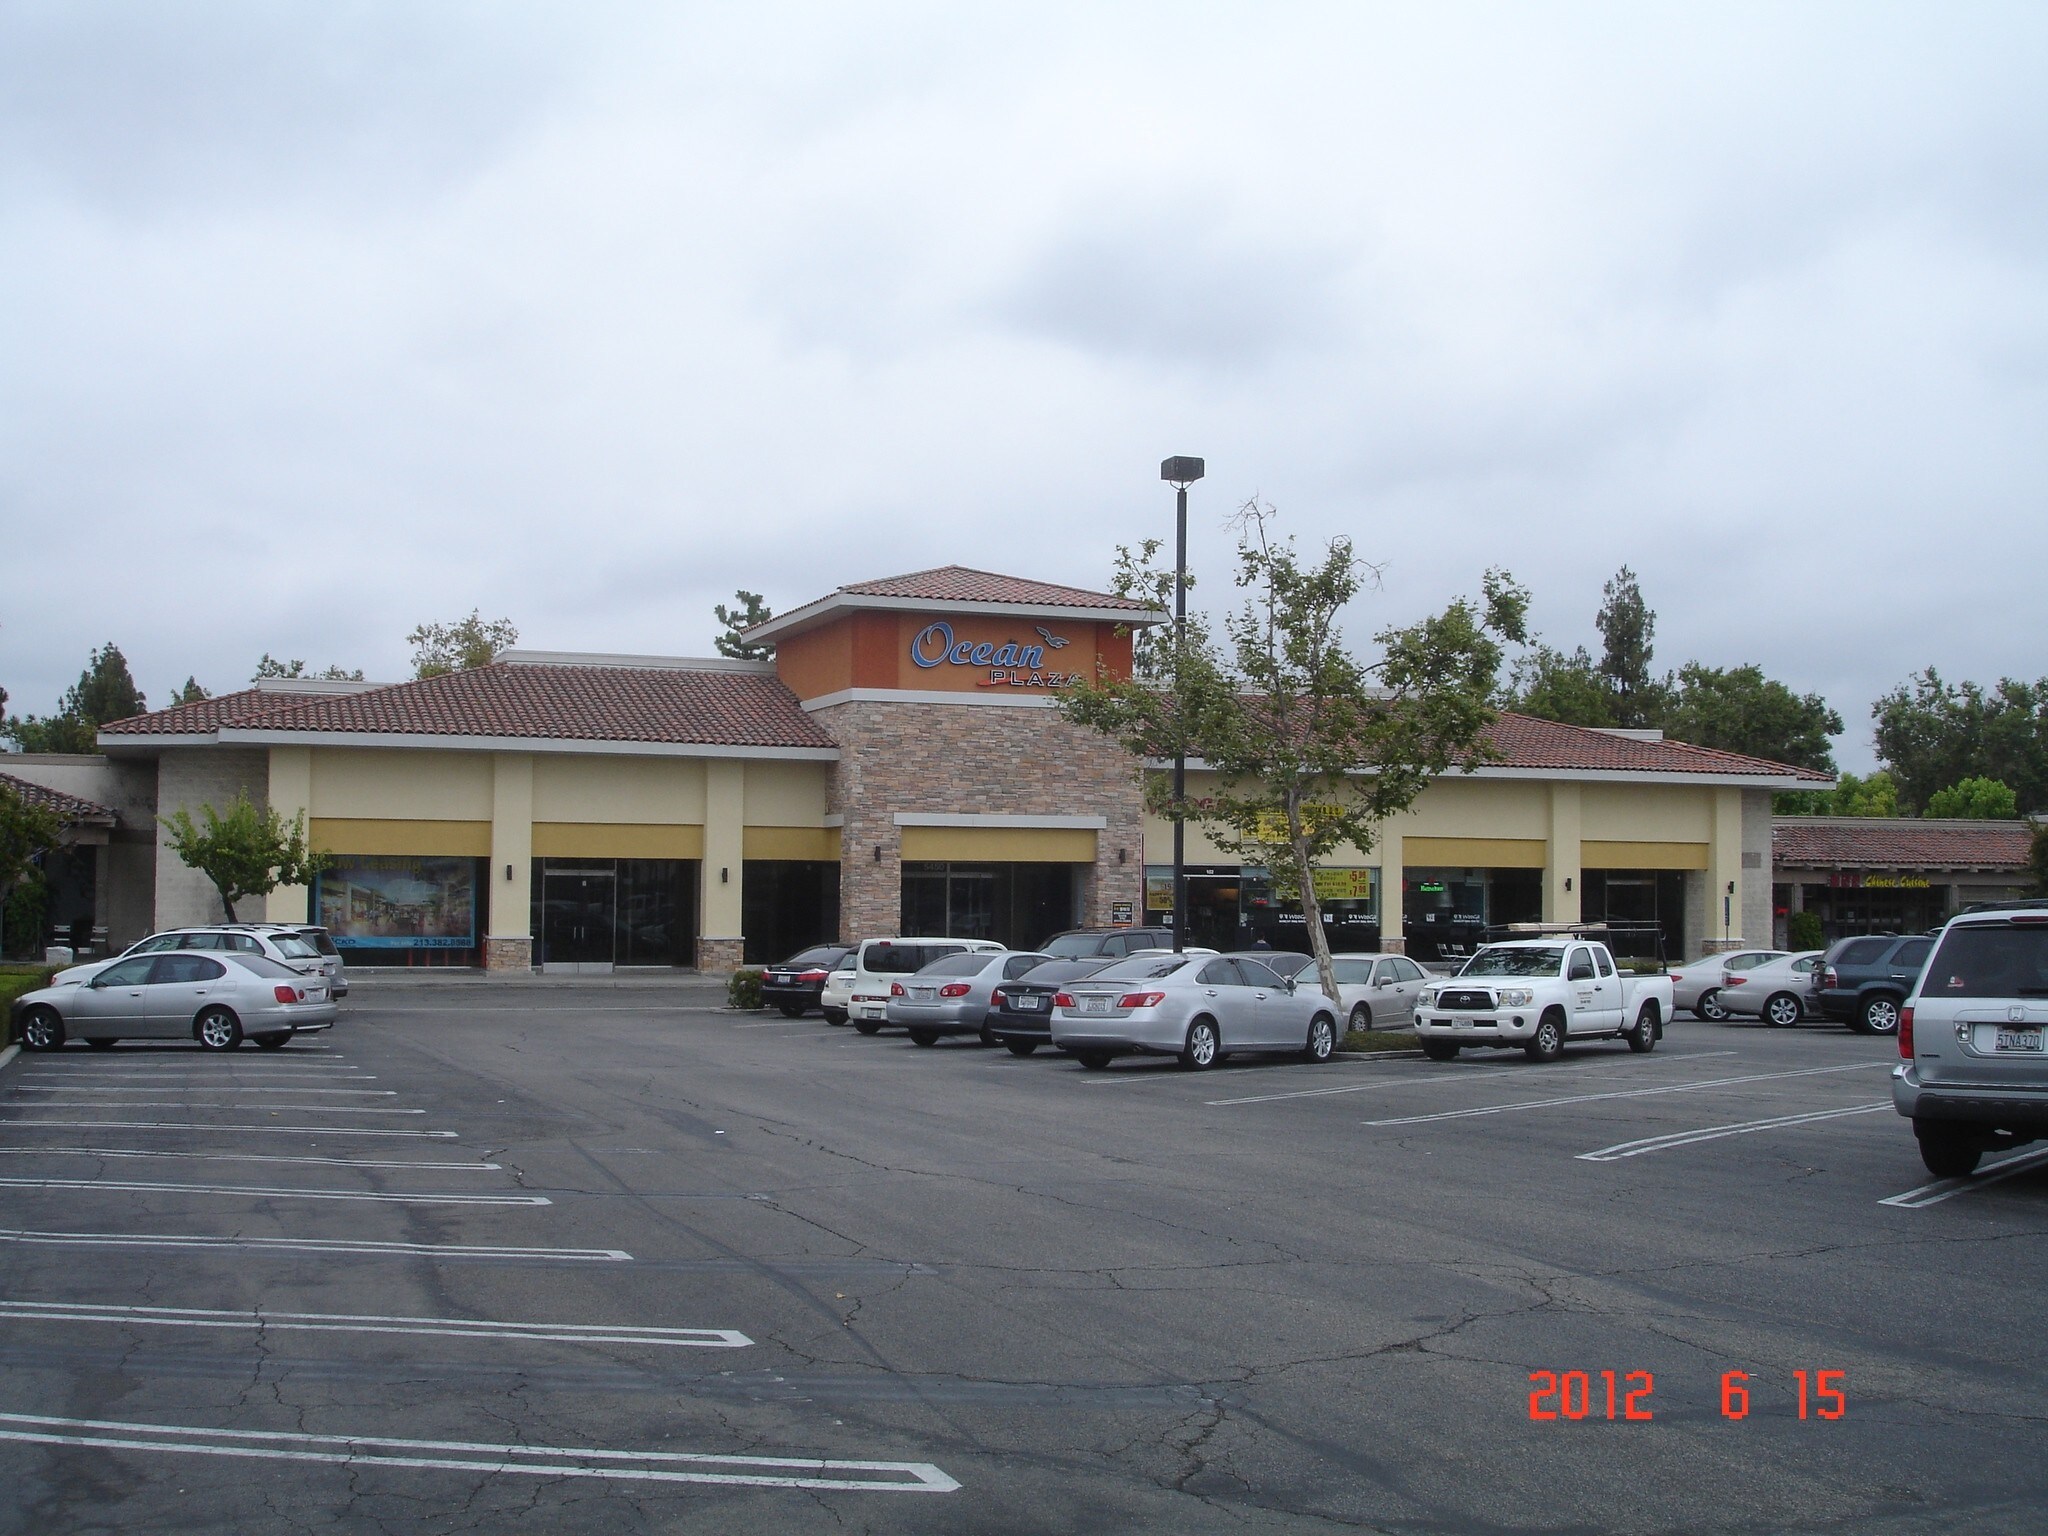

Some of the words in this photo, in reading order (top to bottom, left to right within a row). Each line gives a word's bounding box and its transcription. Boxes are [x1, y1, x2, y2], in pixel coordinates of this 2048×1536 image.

[911, 621, 1044, 669] Ocean
[990, 669, 1083, 688] PLAZA
[1864, 874, 1896, 887] Chinese
[1899, 875, 1930, 888] Cuisine
[1997, 1034, 2040, 1047] 5TNA370
